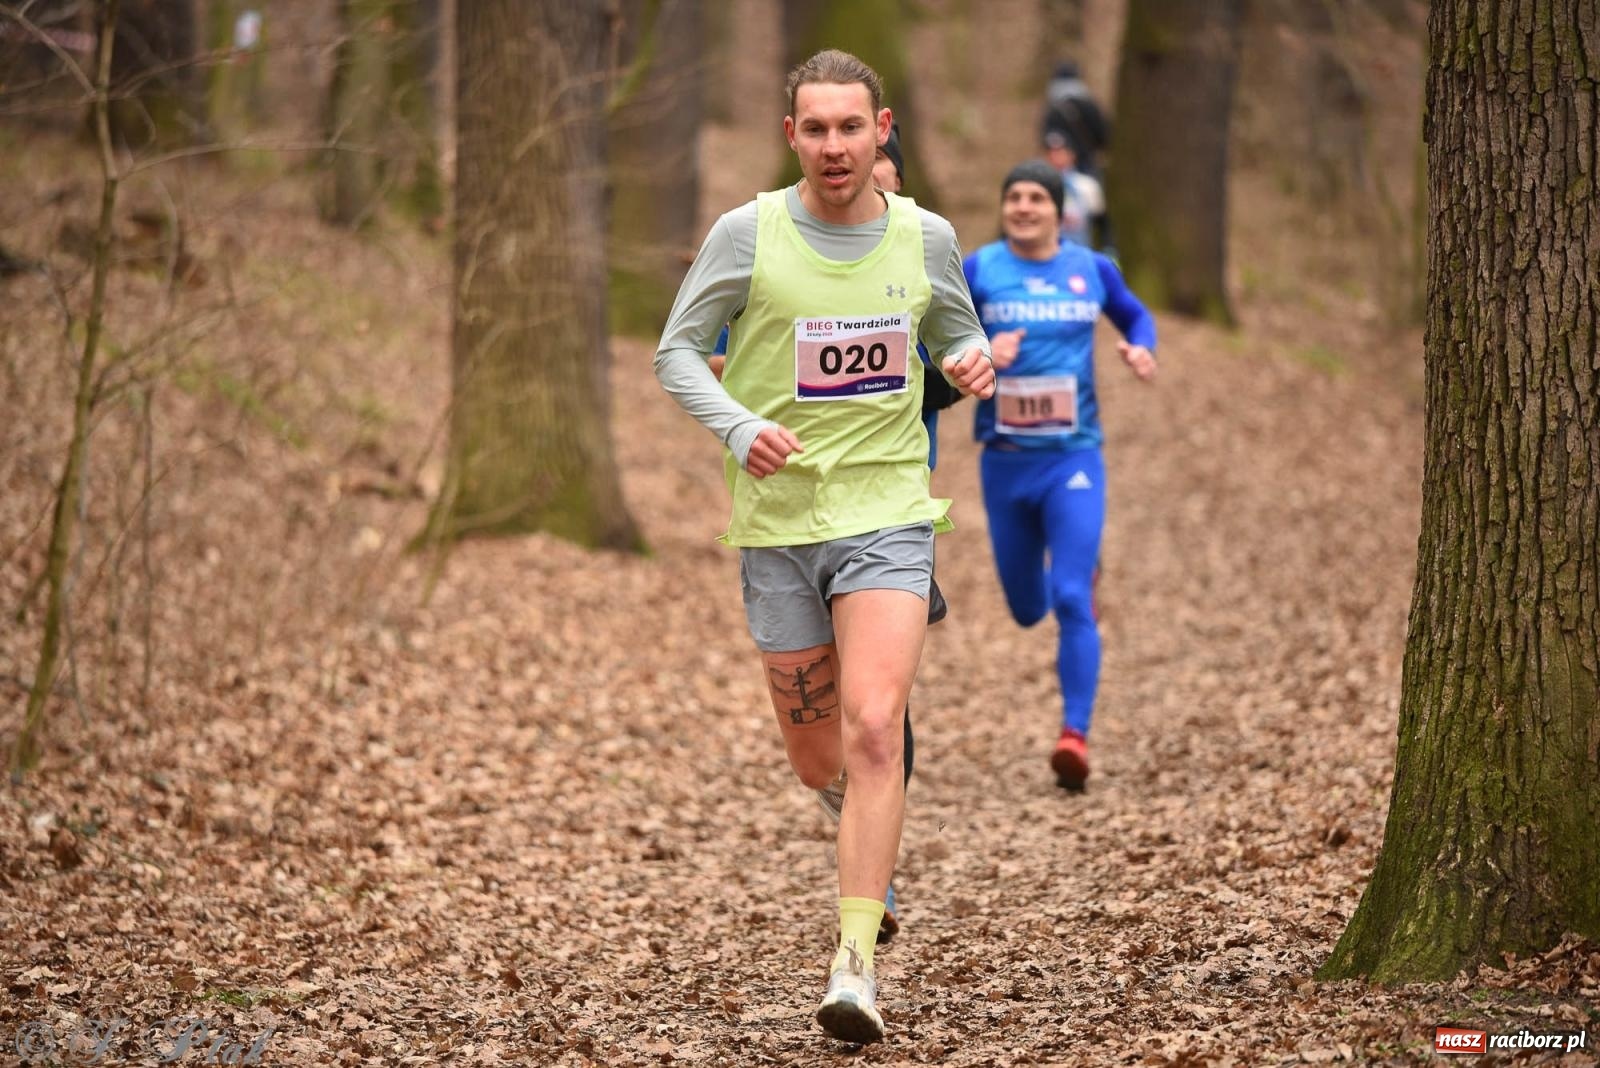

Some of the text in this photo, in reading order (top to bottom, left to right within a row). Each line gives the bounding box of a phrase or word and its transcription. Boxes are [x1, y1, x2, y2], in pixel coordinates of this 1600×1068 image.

[982, 302, 1099, 322] RUNNERS
[806, 317, 901, 331] BIEG Twardziela
[819, 342, 888, 376] 020
